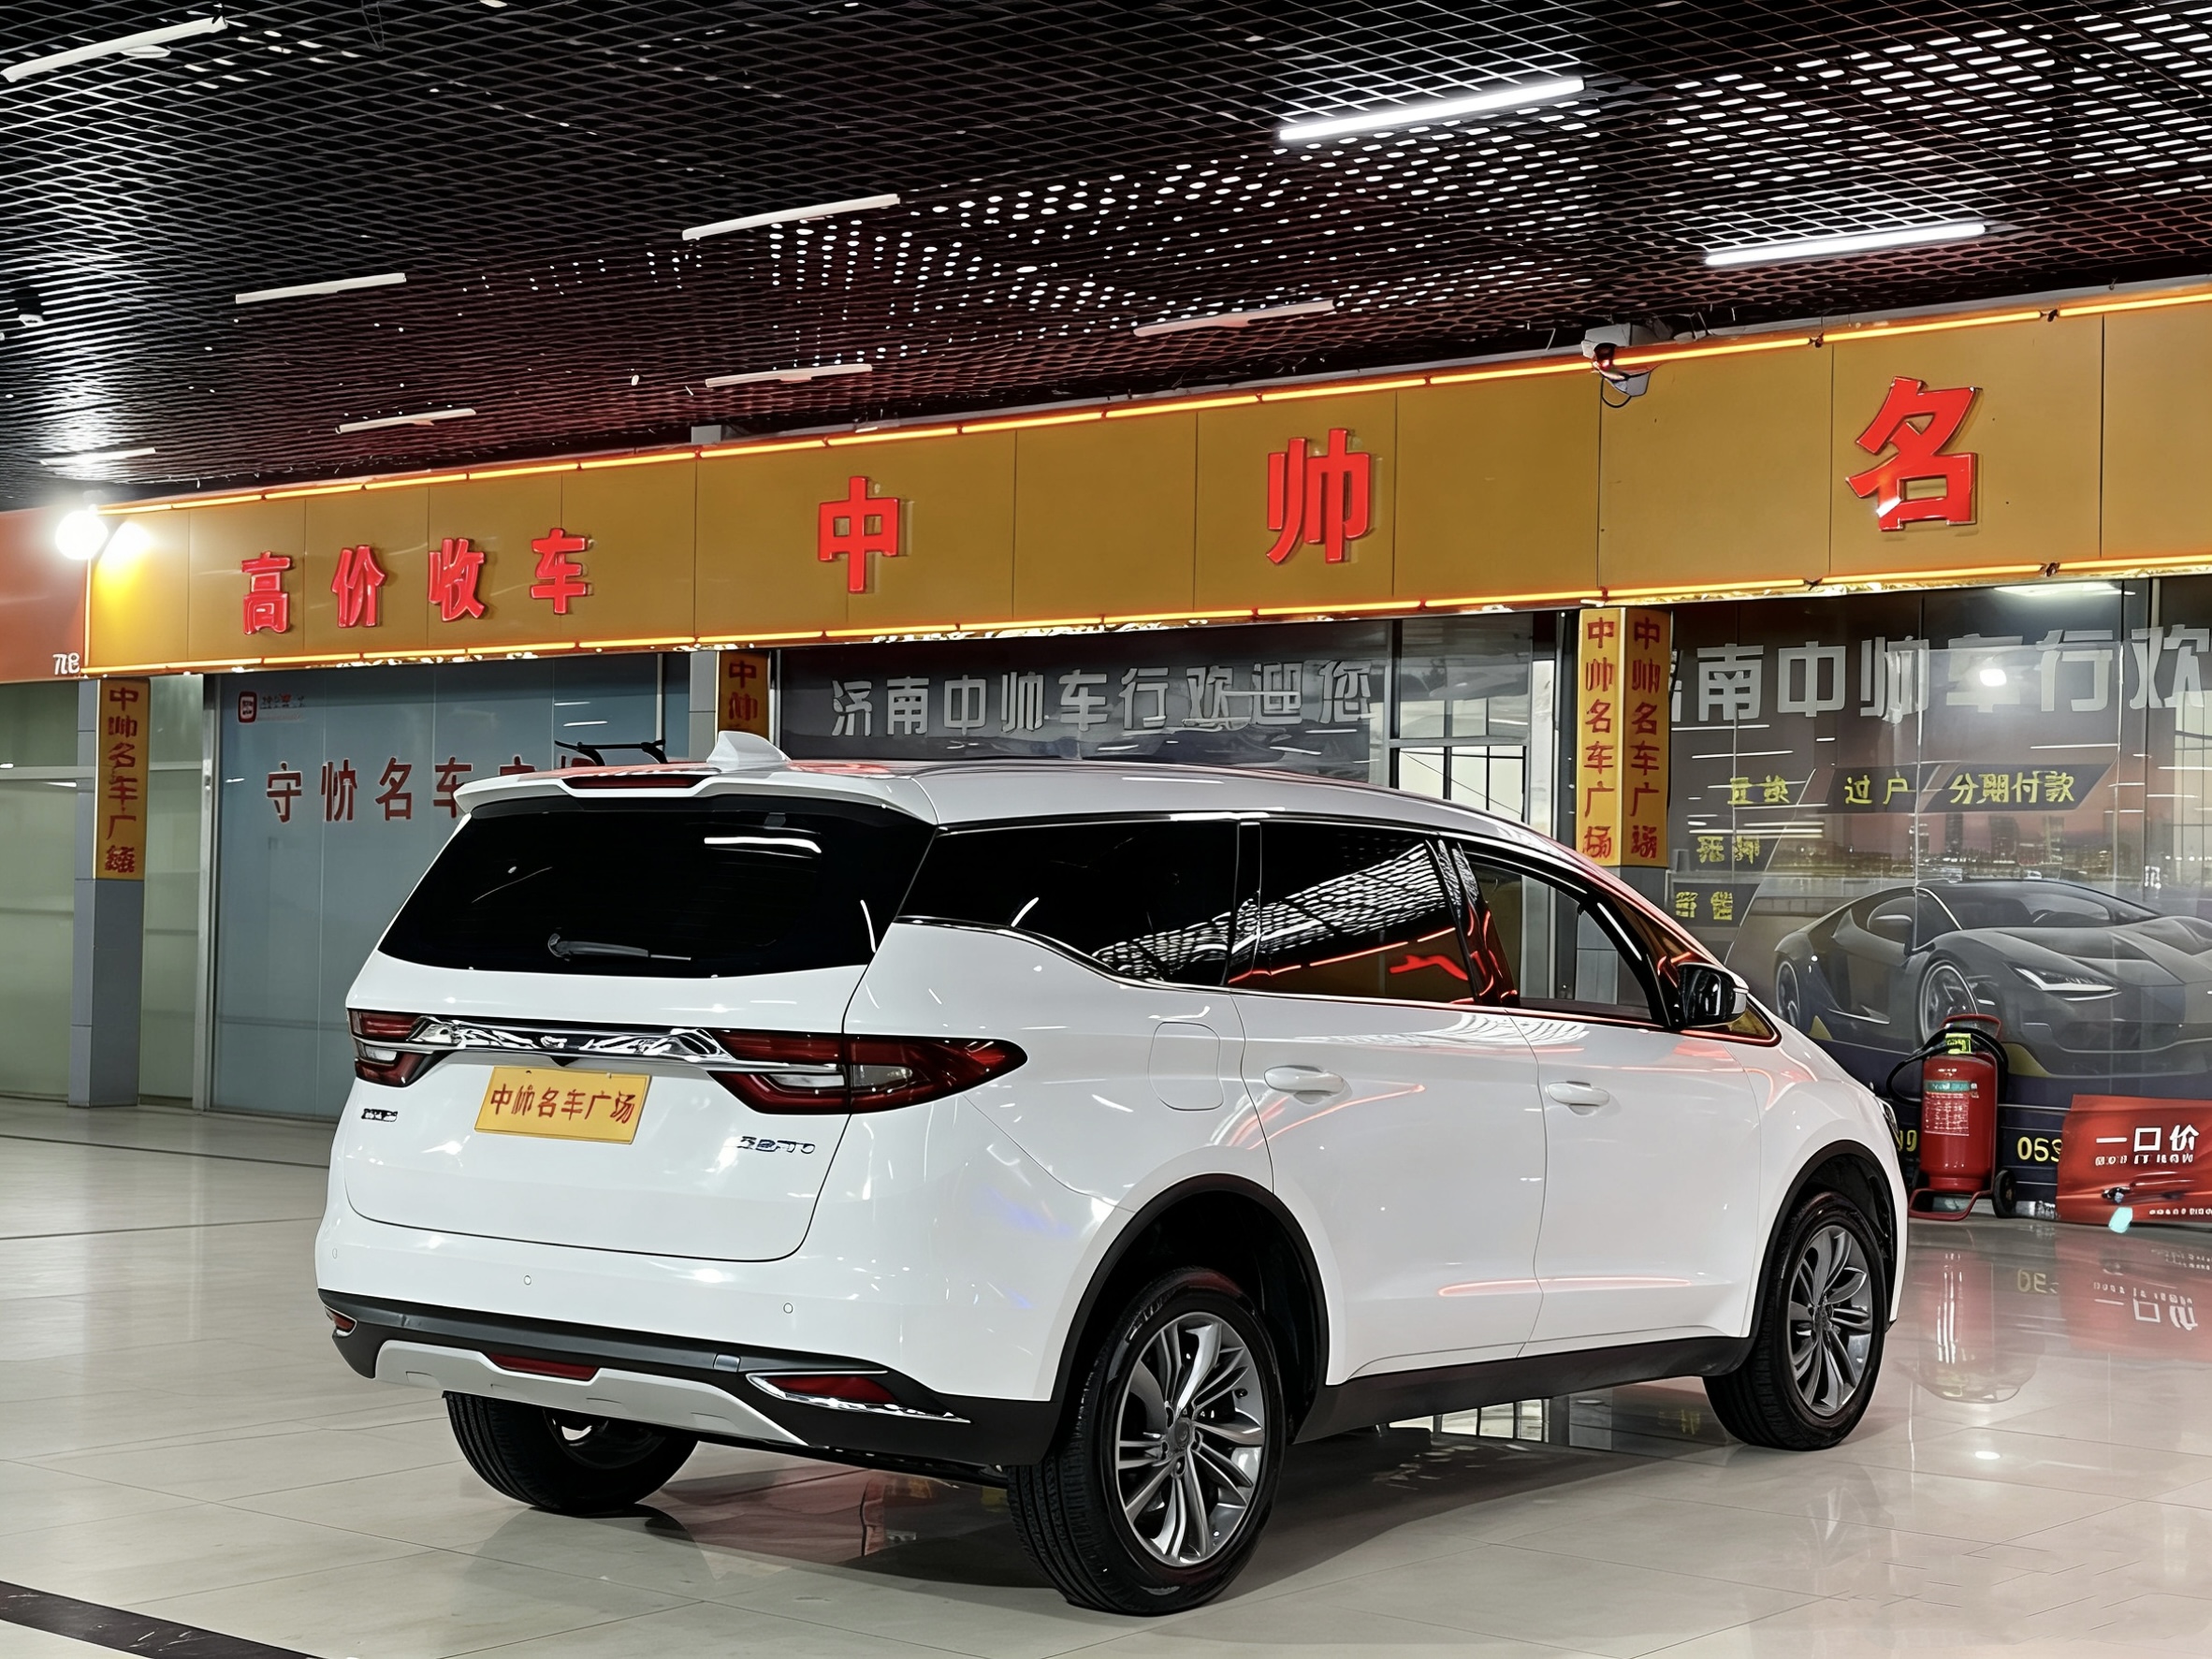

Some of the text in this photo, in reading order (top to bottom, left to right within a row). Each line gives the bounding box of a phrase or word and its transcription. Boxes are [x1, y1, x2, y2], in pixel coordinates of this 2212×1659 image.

[240, 528, 589, 634] 高价收车
[728, 660, 759, 728] 中帅
[1671, 624, 2210, 723] 南中帅车行欢
[2095, 1125, 2200, 1153] 一口价
